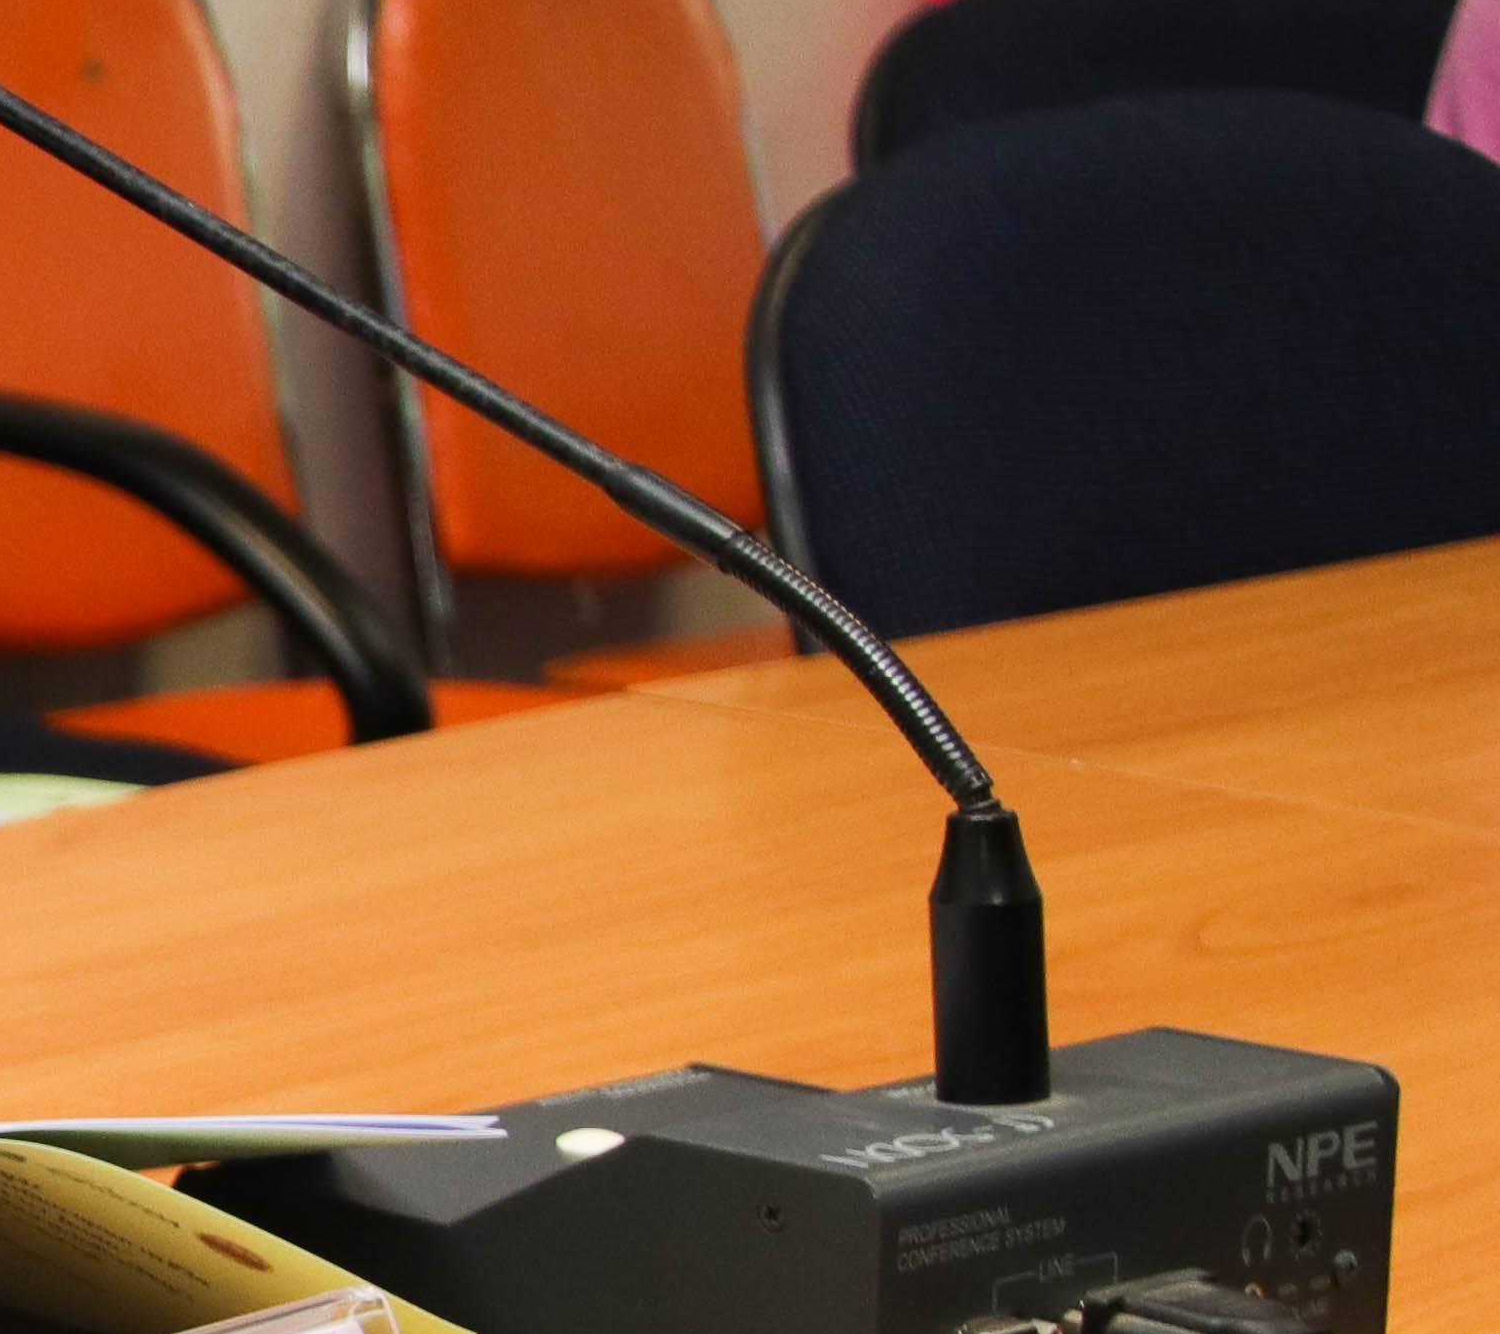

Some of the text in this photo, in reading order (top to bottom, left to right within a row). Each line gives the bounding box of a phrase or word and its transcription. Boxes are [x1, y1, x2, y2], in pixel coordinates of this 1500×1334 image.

[1267, 1120, 1379, 1187] NPE
[898, 1206, 1011, 1246] PROFESSIONAL
[898, 1217, 1067, 1274] CONFERENCE SYSTEM
[1038, 1251, 1077, 1283] LINE
